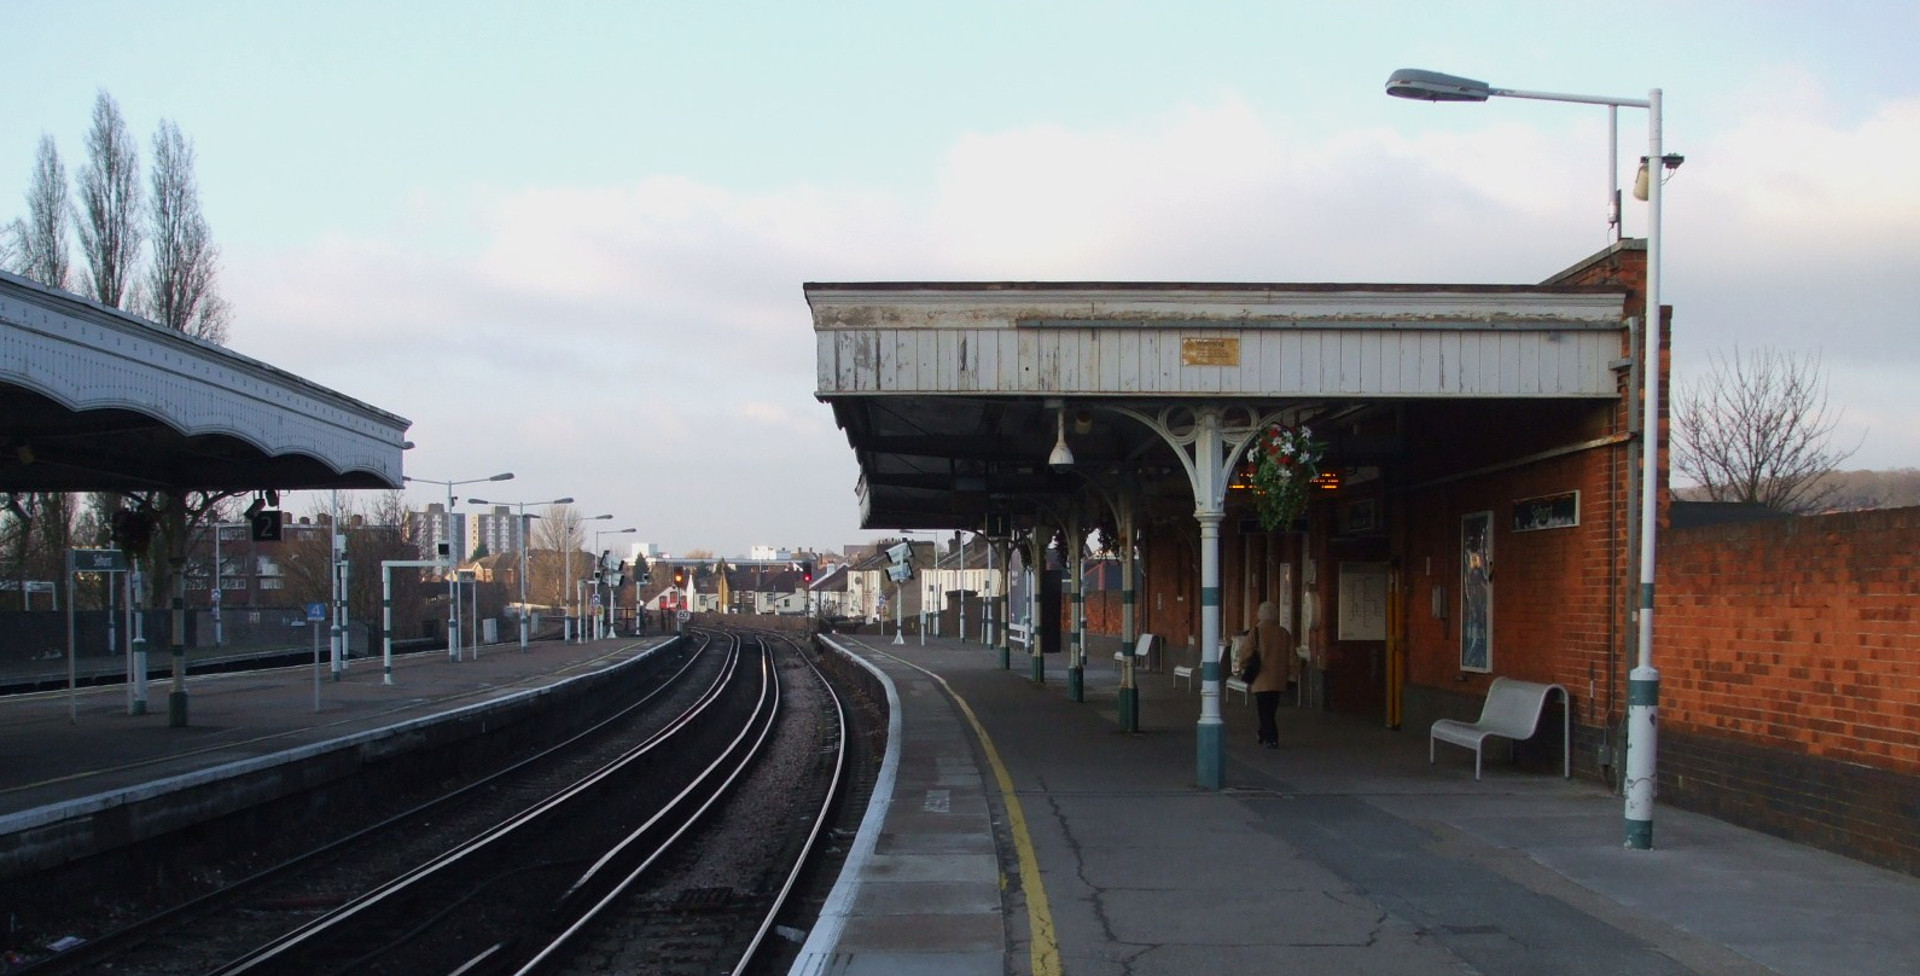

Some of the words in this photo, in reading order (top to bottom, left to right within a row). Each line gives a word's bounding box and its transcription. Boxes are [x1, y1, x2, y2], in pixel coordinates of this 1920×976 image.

[260, 515, 273, 537] 2
[996, 516, 1002, 534] 1
[311, 604, 321, 615] 4
